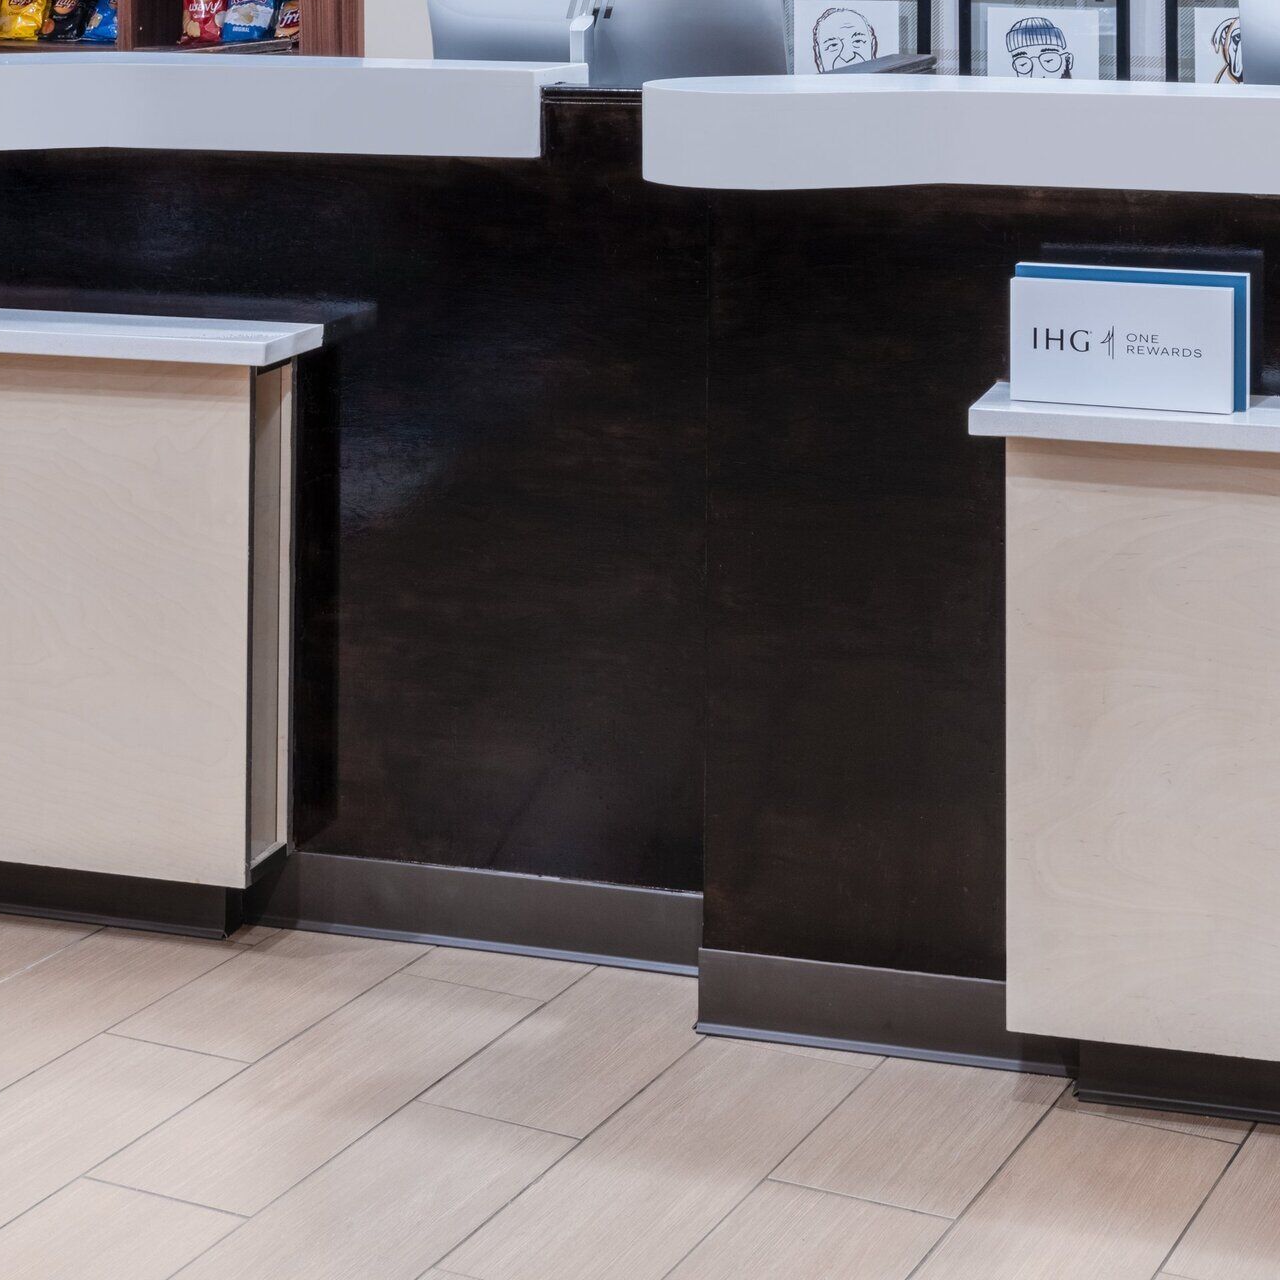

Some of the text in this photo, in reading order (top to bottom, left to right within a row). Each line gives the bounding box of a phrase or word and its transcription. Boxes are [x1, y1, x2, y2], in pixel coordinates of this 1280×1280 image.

[1032, 327, 1090, 353] IHG
[1125, 332, 1160, 345] ONE
[1125, 344, 1203, 359] REWARDS
